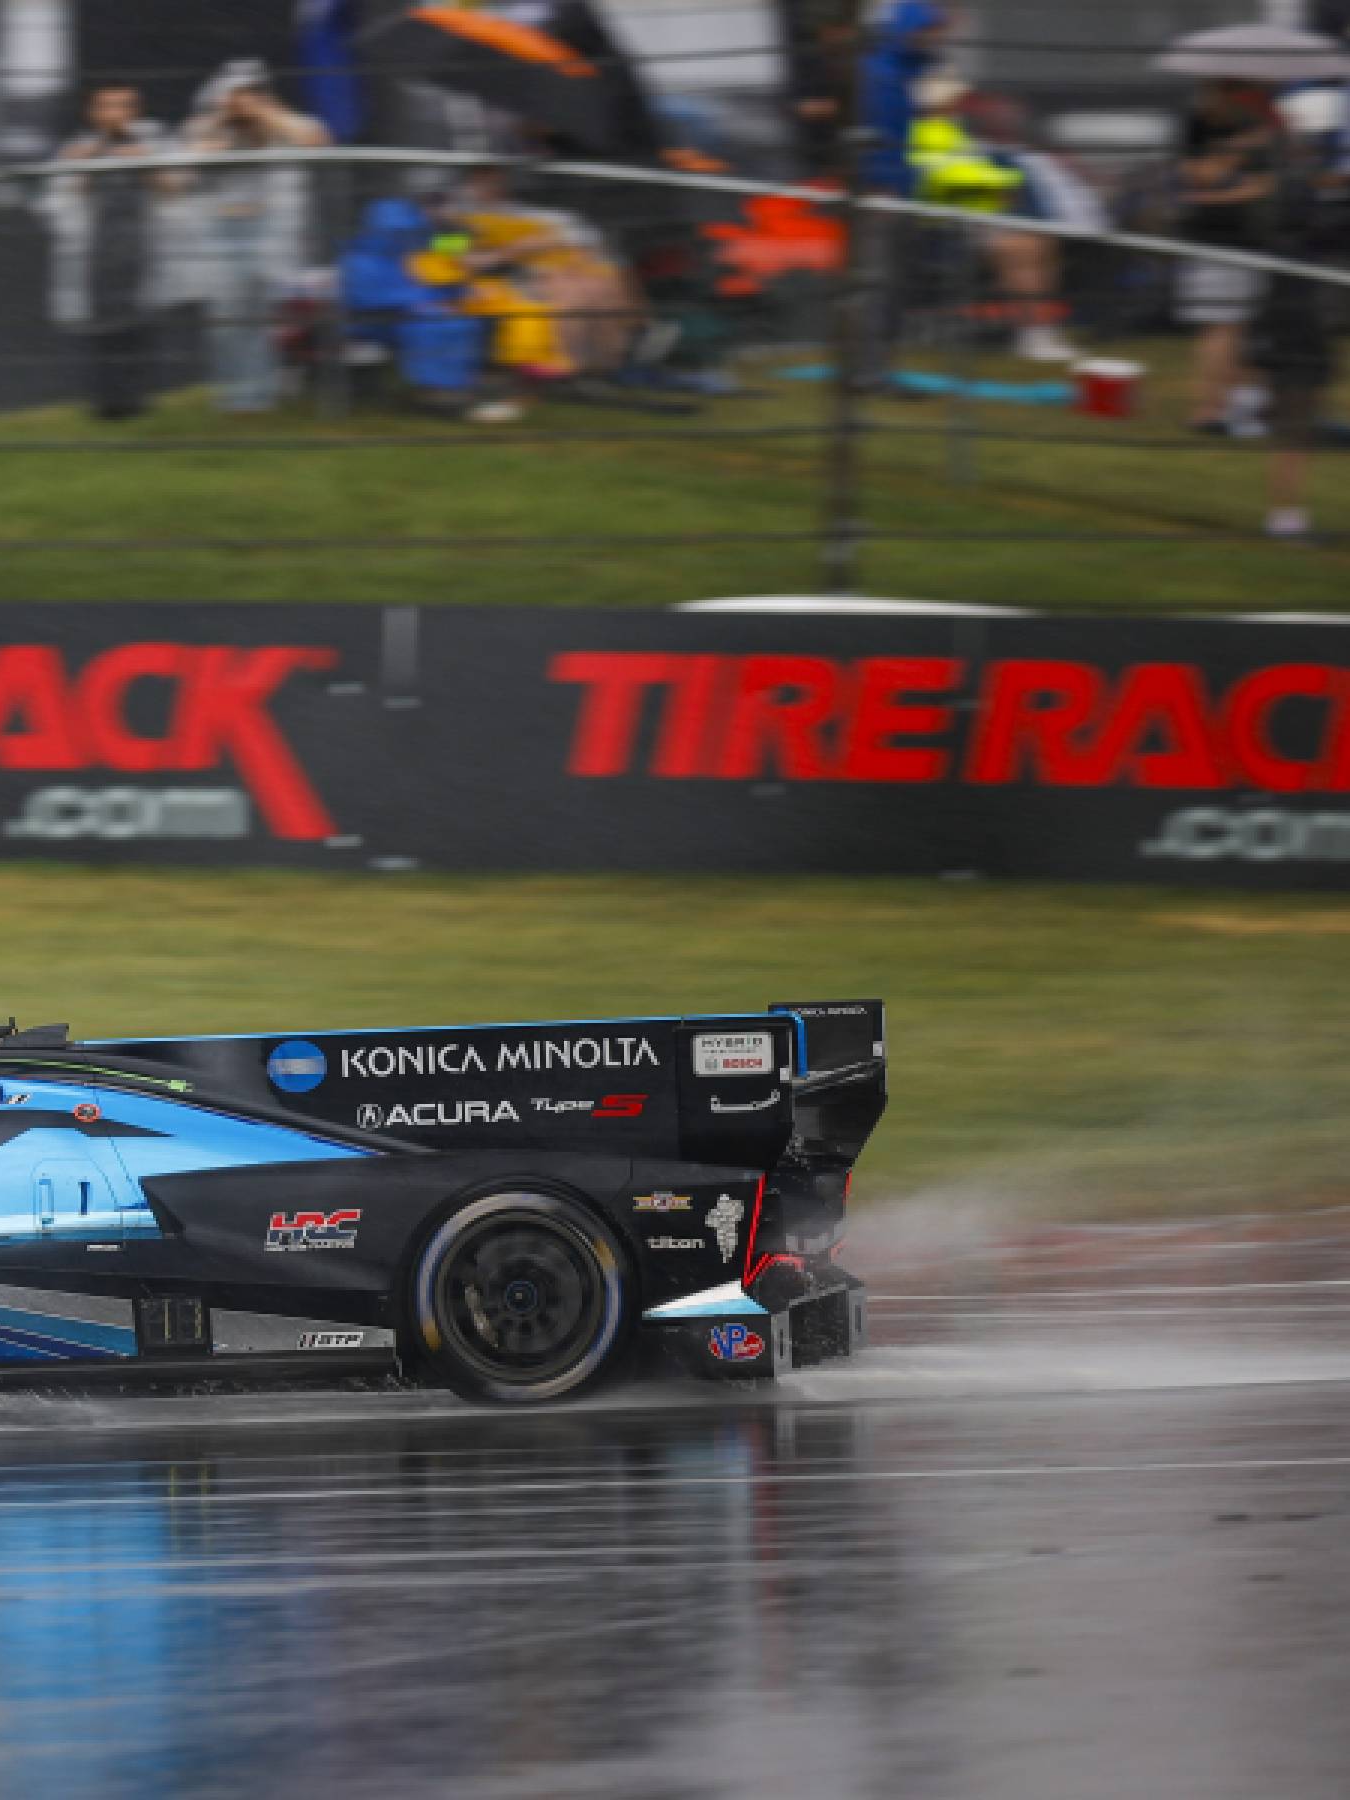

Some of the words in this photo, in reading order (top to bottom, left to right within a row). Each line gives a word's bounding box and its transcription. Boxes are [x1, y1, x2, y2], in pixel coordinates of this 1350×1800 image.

[965, 660, 1350, 793] RAC
[342, 1044, 487, 1077] KONICA
[497, 1037, 660, 1071] MINOLTA
[385, 1100, 521, 1126] ACURA
[266, 1209, 360, 1243] HRC
